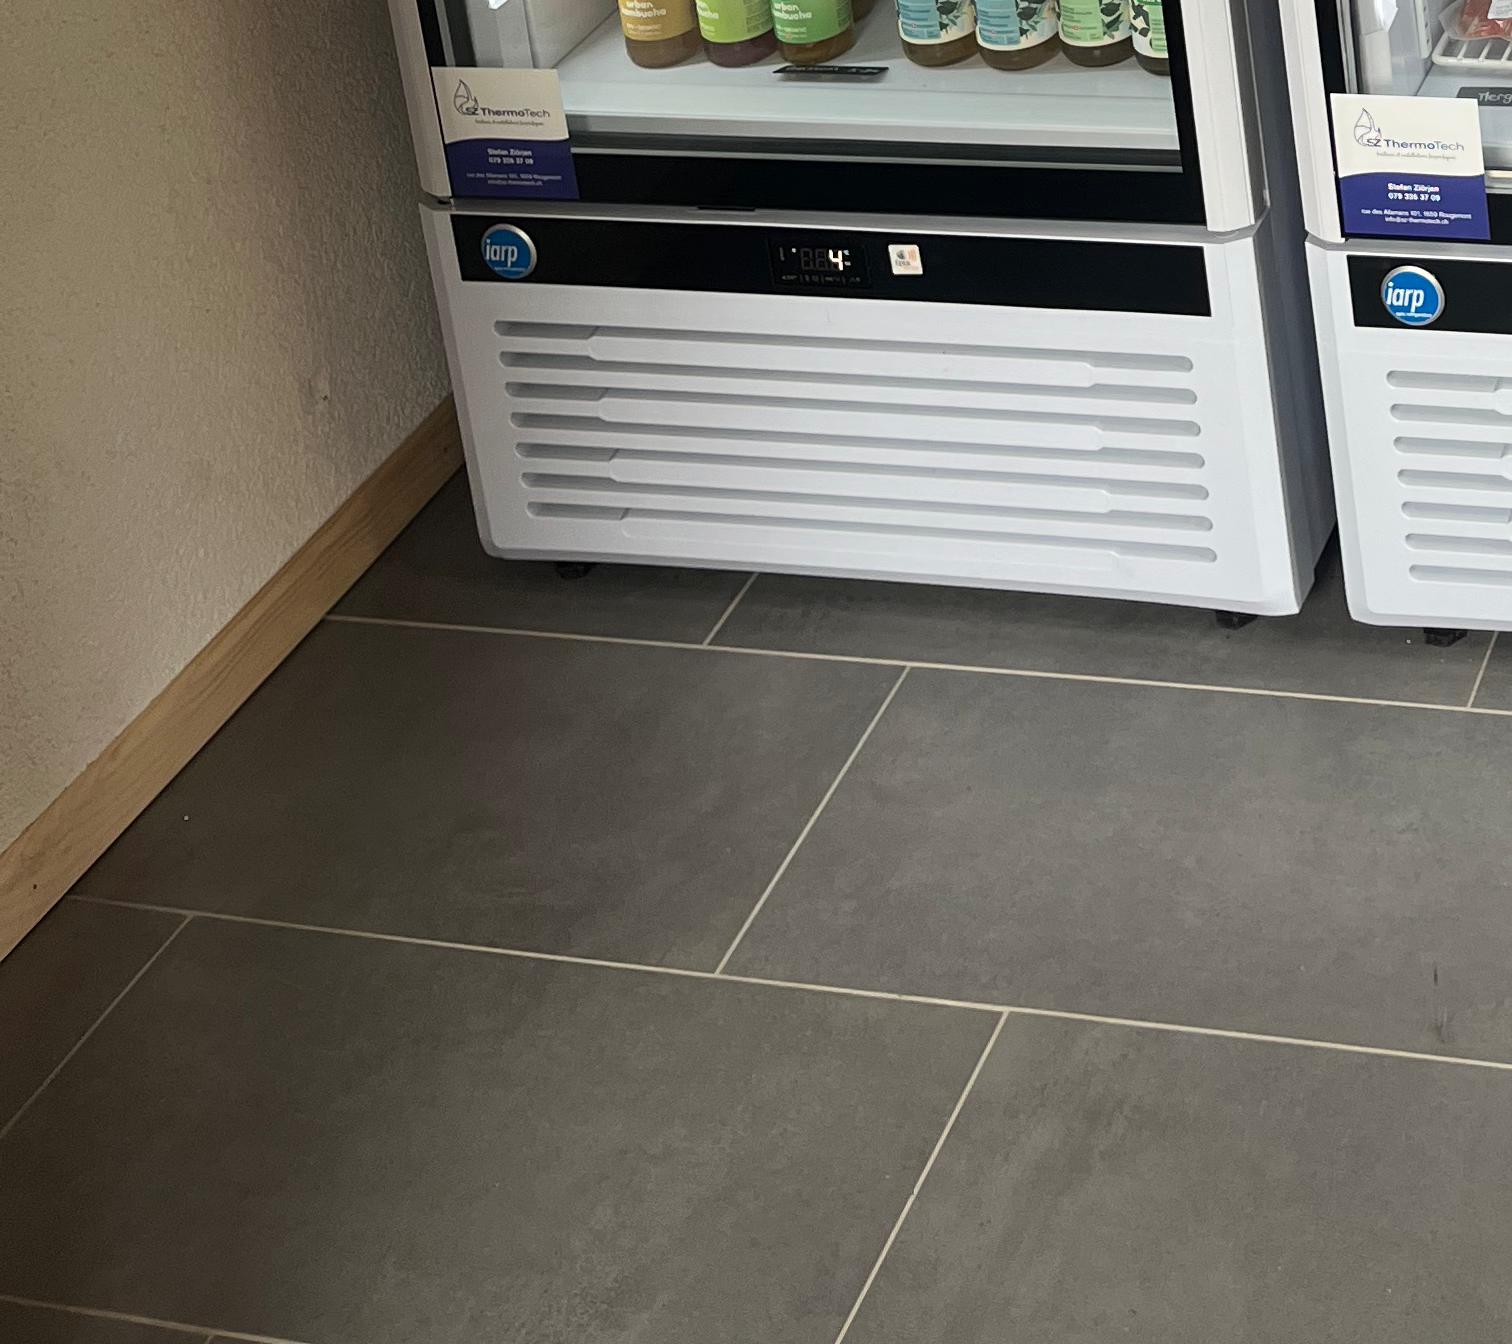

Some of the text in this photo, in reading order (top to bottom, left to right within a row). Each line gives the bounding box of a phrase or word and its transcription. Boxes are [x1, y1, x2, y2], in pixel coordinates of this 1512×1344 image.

[480, 107, 550, 118] ThermoTech
[1384, 139, 1464, 151] ThermoTech
[486, 239, 517, 267] iarp
[829, 249, 843, 270] 4
[1386, 282, 1424, 312] iarp
